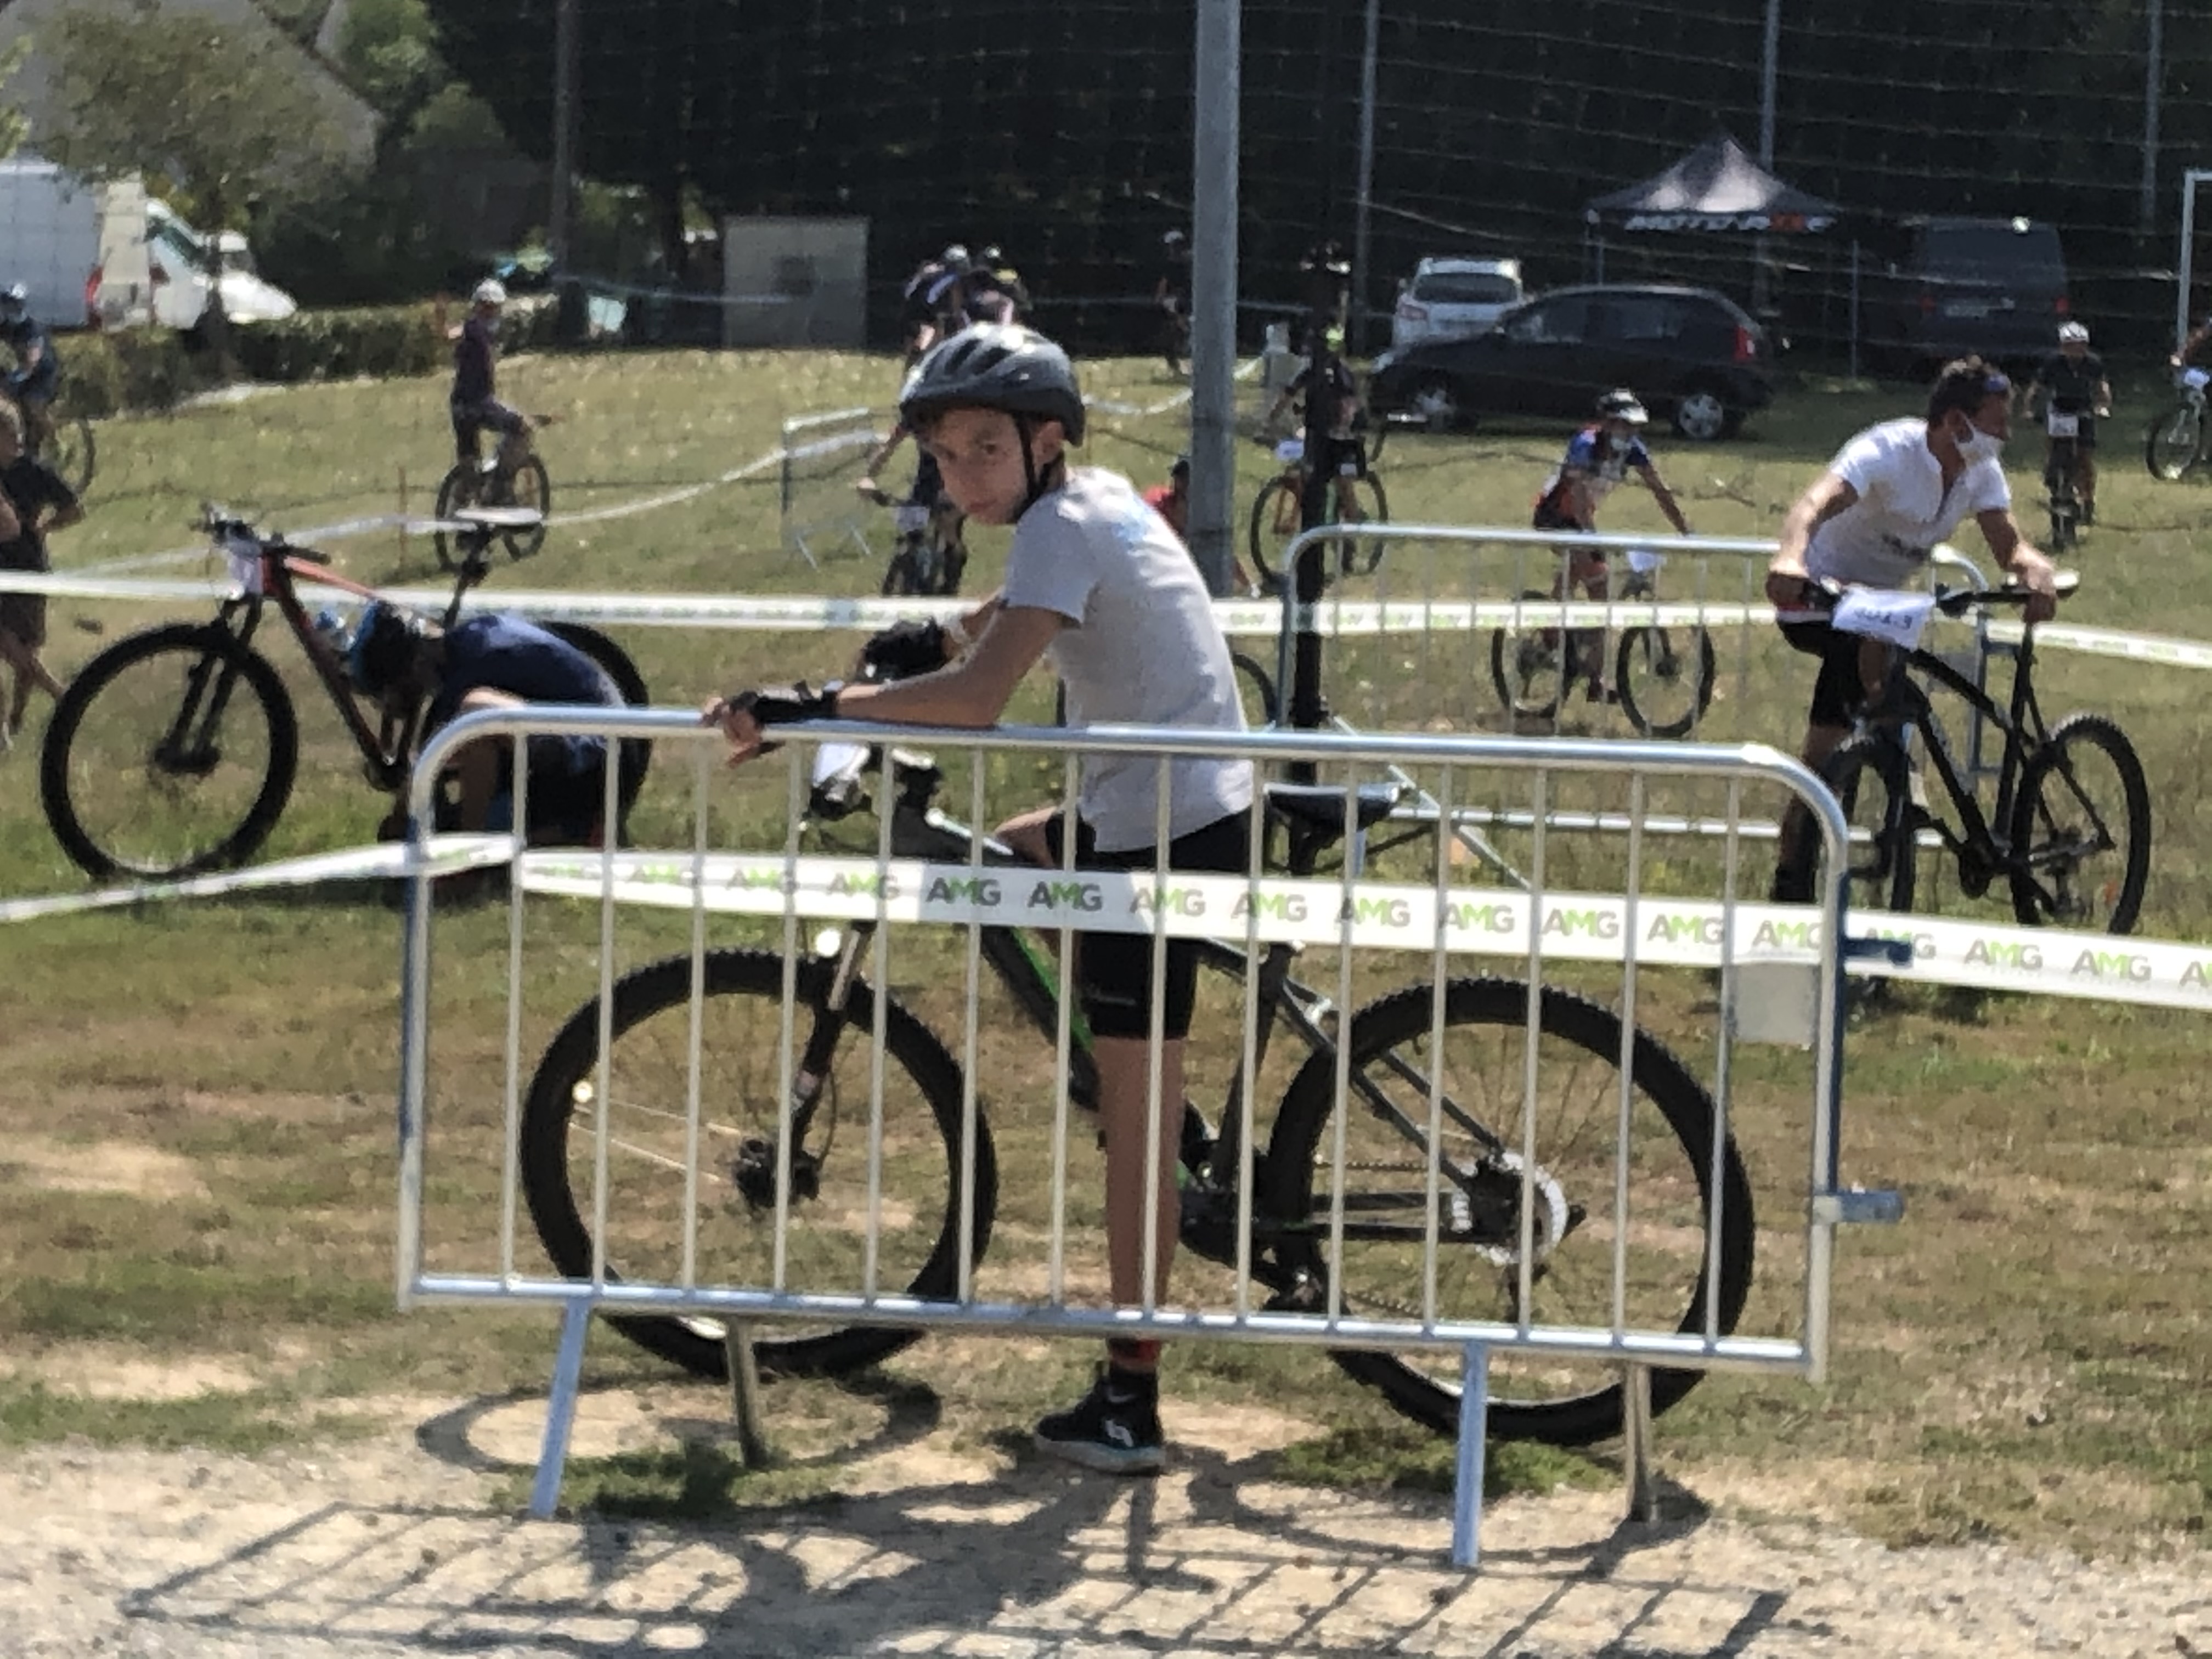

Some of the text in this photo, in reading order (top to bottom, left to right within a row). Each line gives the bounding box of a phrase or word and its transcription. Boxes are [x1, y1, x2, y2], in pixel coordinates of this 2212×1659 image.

[927, 877, 1001, 907] AMG
[1028, 880, 1103, 912] AMG
[1129, 885, 1205, 917] AMG
[1231, 892, 1308, 922] AMG
[1334, 898, 1411, 928] AMG
[1437, 902, 1515, 934] AMG
[1541, 908, 1620, 939] AMG
[1647, 913, 1725, 946] AMG
[1963, 937, 2044, 970] AMG
[2070, 949, 2153, 982] AMG
